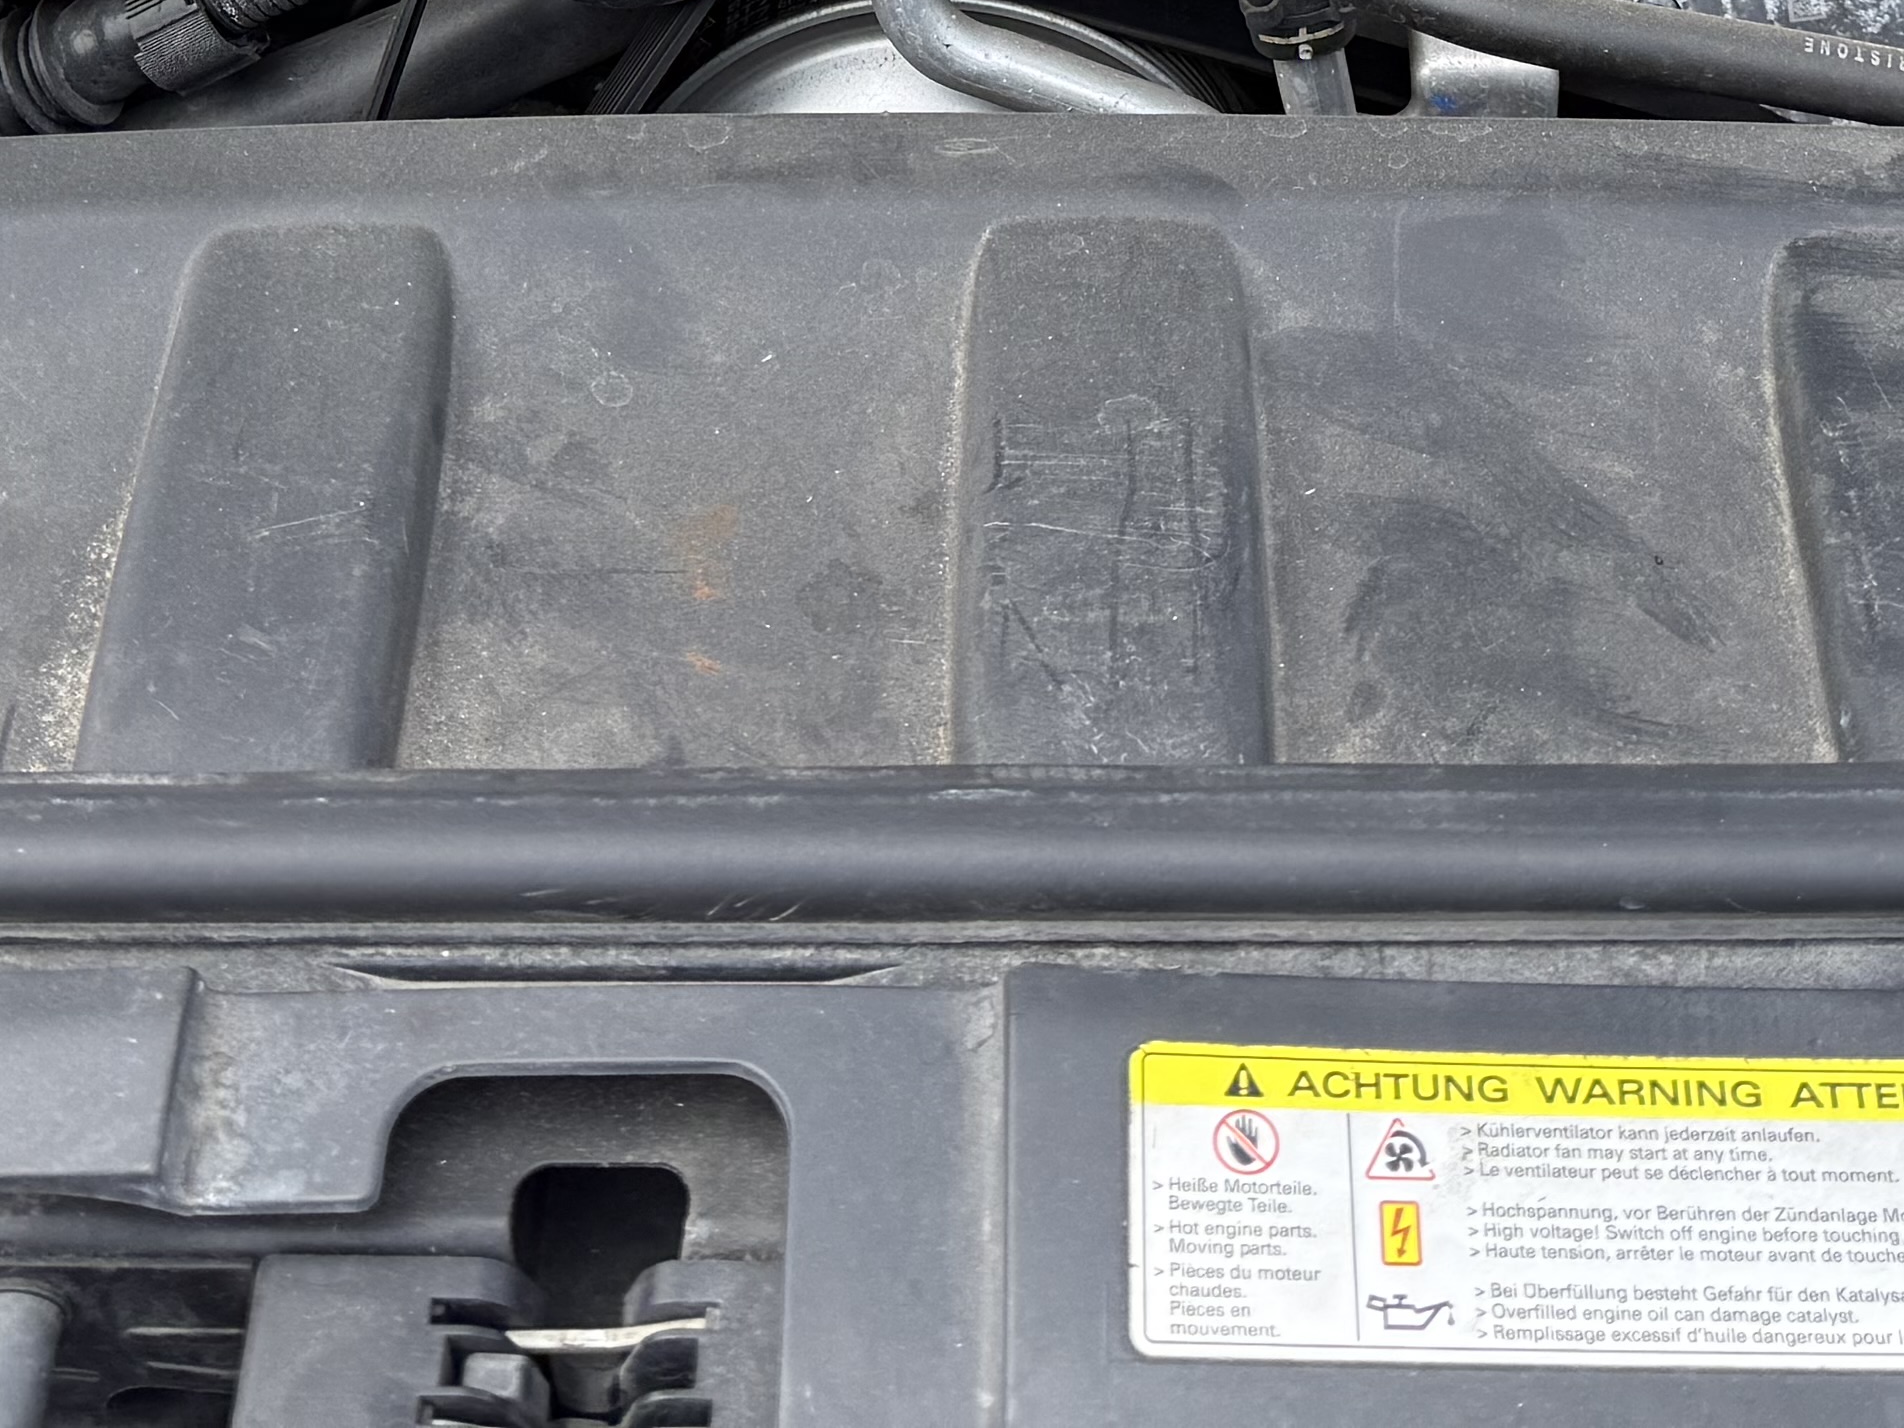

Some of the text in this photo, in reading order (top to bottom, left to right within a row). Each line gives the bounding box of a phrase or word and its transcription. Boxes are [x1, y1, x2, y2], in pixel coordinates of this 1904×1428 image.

[1288, 1070, 1509, 1103] ACHTUNG
[1536, 1076, 1763, 1109] WARNING
[1477, 1122, 1820, 1144] Kühlerventilator kann jederzeit anlaufen.
[1478, 1142, 1773, 1164] Radiator fan may start any time.
[1480, 1162, 1900, 1183] Le ventilateur peut déclencher tout moment.
[1169, 1177, 1317, 1196] Heiße Motorteile.
[1169, 1195, 1292, 1215] Bewegte Teile.
[1482, 1202, 1619, 1222] Hochspannung,
[1622, 1207, 1651, 1220] vor
[1657, 1205, 1736, 1221] Berühren
[1742, 1206, 1770, 1222] der
[1774, 1206, 1877, 1225] Zündanlage
[1169, 1219, 1317, 1239] Hot engine parts.
[1484, 1222, 1524, 1241] High
[1530, 1223, 1599, 1242] voltage!
[1606, 1224, 1664, 1241] Switch
[1670, 1226, 1694, 1241] off
[1699, 1227, 1757, 1244] engine
[1763, 1226, 1818, 1242] before
[1823, 1227, 1900, 1246] touching
[1169, 1238, 1287, 1258] Moving parts.
[1485, 1243, 1536, 1259] Haute
[1541, 1244, 1610, 1262] tension,
[1616, 1244, 1674, 1261] arrêter
[1700, 1248, 1762, 1262] moteur
[1768, 1249, 1816, 1263] avant
[1170, 1262, 1322, 1282] Pièces du moteur
[1169, 1282, 1247, 1298] chaudes.
[1490, 1282, 1518, 1298] Bei
[1633, 1285, 1698, 1301] besteht
[1703, 1285, 1762, 1302] Gefahr
[1767, 1285, 1793, 1302] für
[1798, 1287, 1830, 1303] den
[1170, 1300, 1251, 1317] Pièces en
[1492, 1303, 1859, 1326] Overfilled engine oil can damage catalyst.
[1170, 1322, 1281, 1337] mouvement.
[1493, 1324, 1606, 1344] Remplissage
[1612, 1327, 1681, 1343] excessif
[1687, 1328, 1747, 1343] d'huile
[1752, 1328, 1846, 1347] dangereux
[1852, 1332, 1892, 1347] pour
